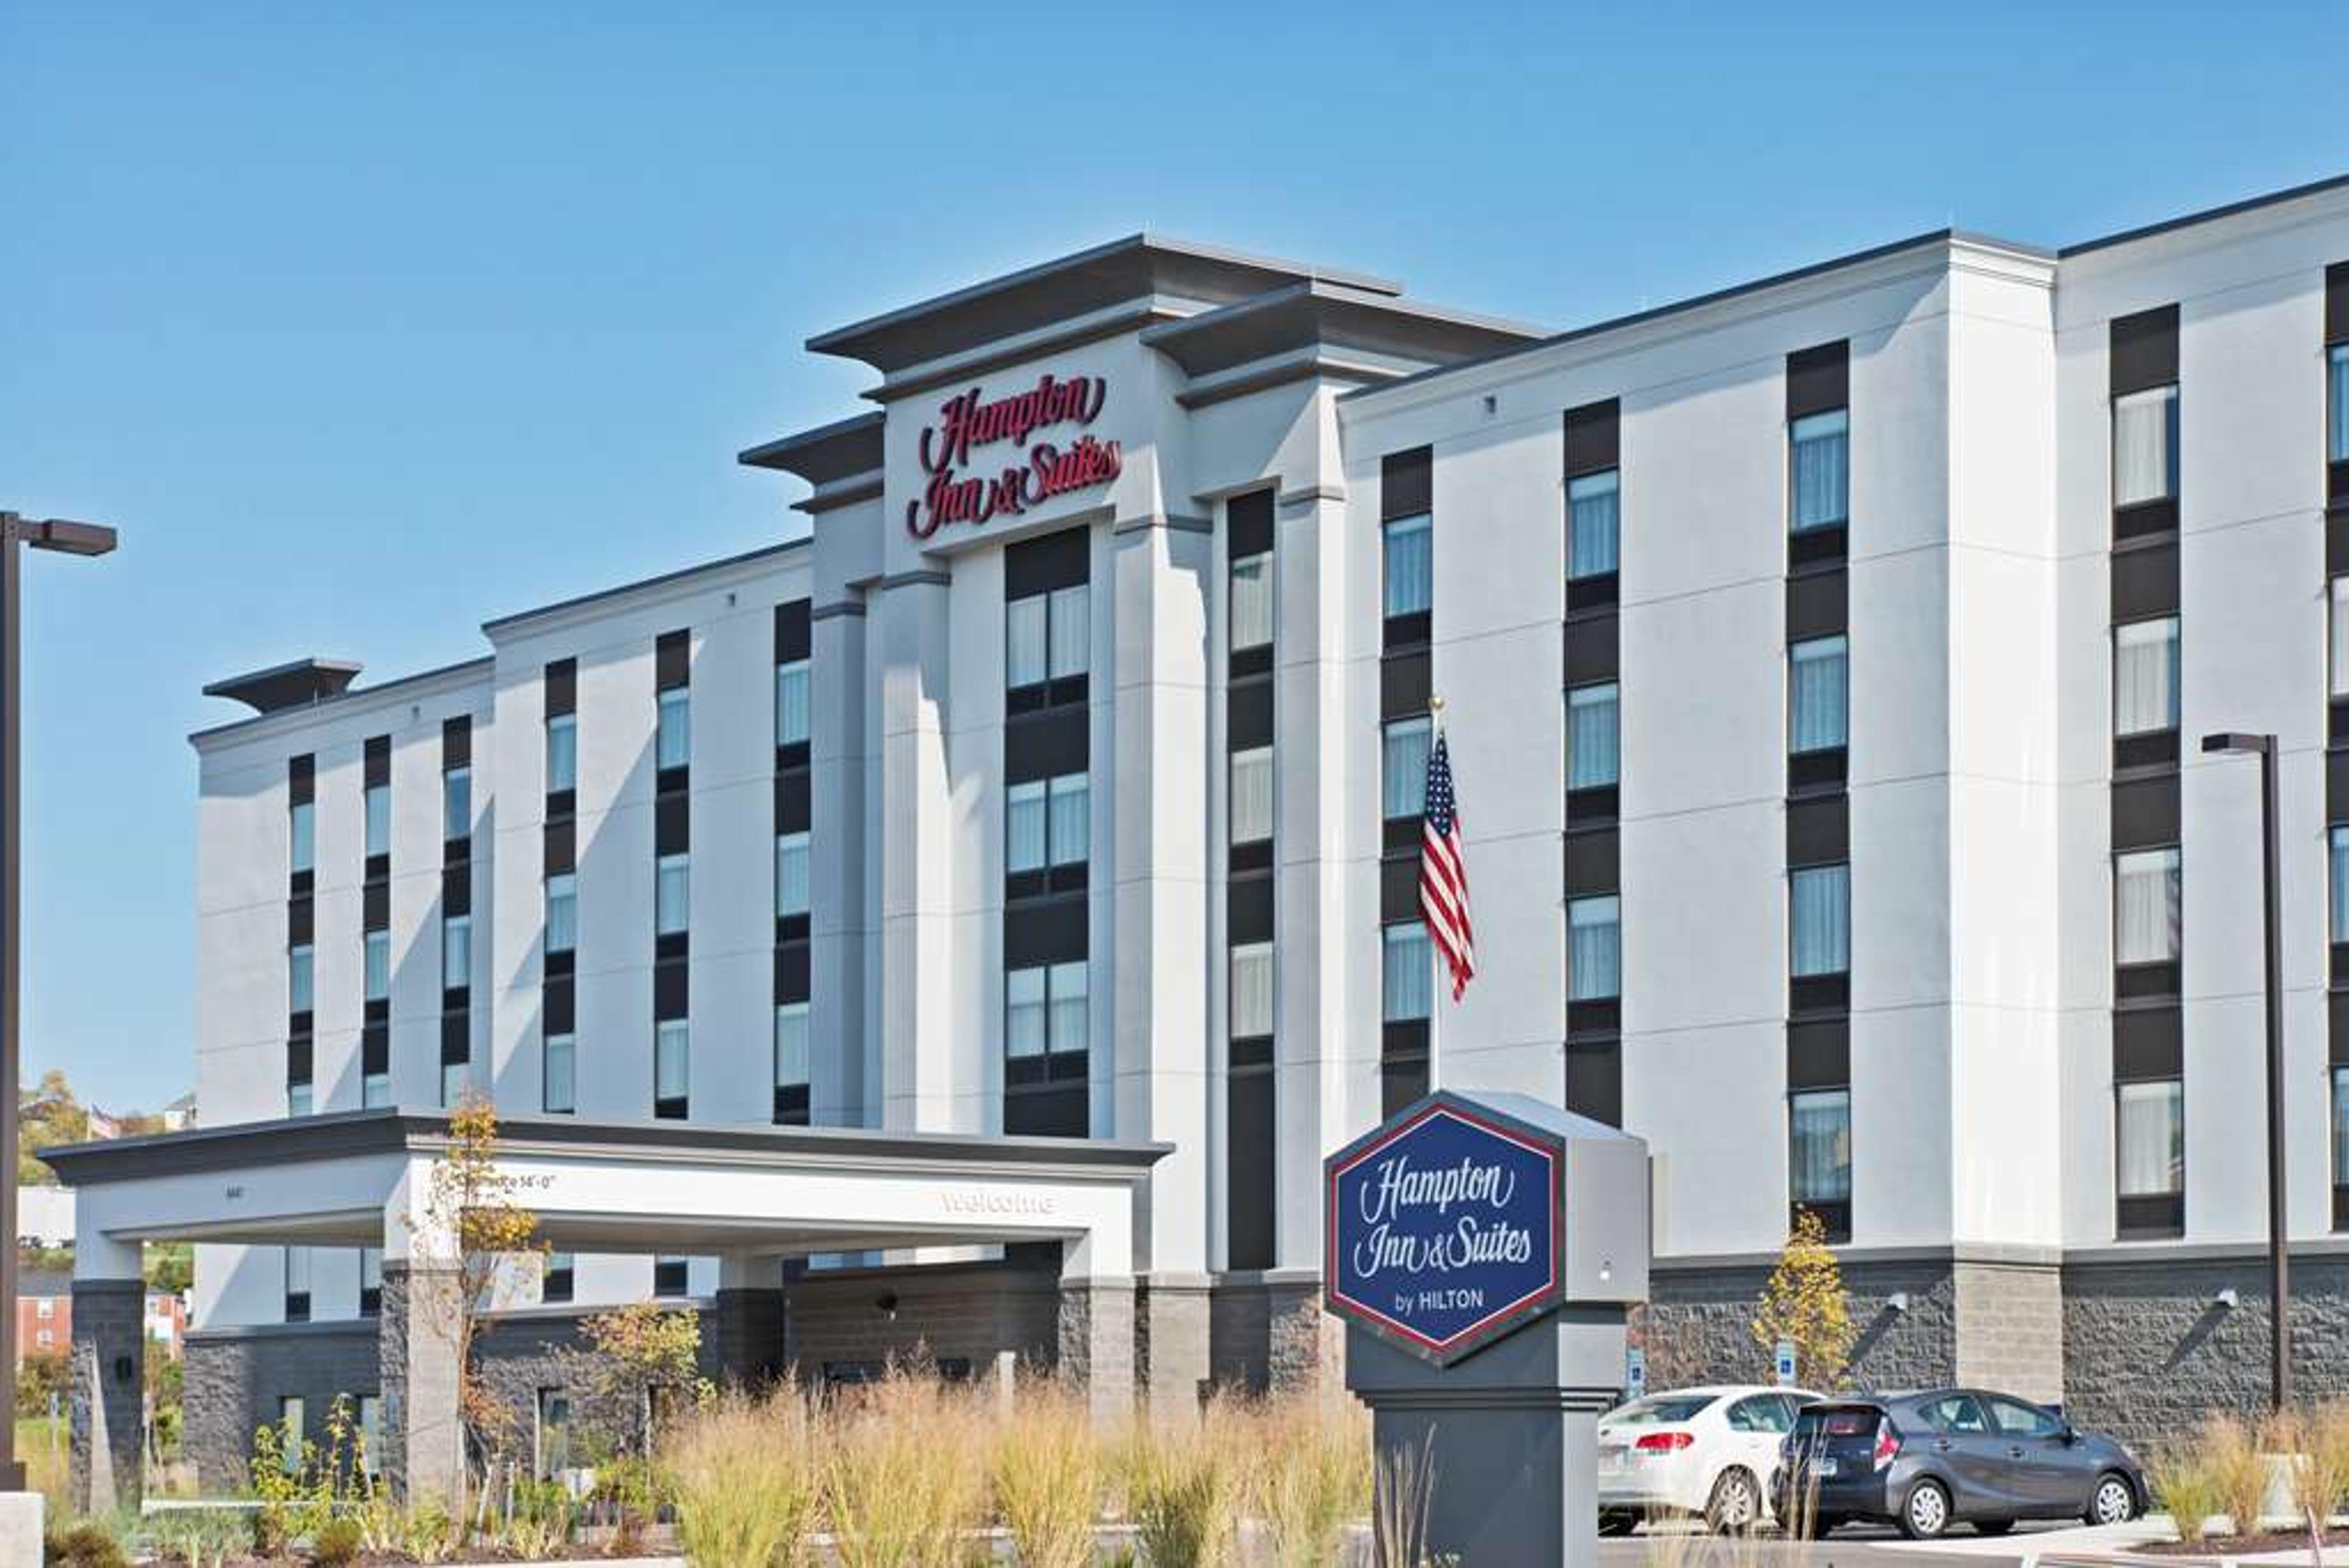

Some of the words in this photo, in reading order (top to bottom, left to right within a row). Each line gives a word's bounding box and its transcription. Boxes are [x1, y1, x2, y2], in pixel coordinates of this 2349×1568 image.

[920, 374, 1107, 473] Hampton
[907, 469, 998, 539] Inn
[994, 468, 1026, 515] &
[1020, 434, 1121, 506] Suites
[1360, 1155, 1515, 1224] Hampton
[1354, 1223, 1429, 1279] Inn
[1430, 1234, 1450, 1273] &
[1446, 1216, 1531, 1268] Suites
[1395, 1294, 1413, 1316] by
[1419, 1289, 1485, 1310] HILTON
